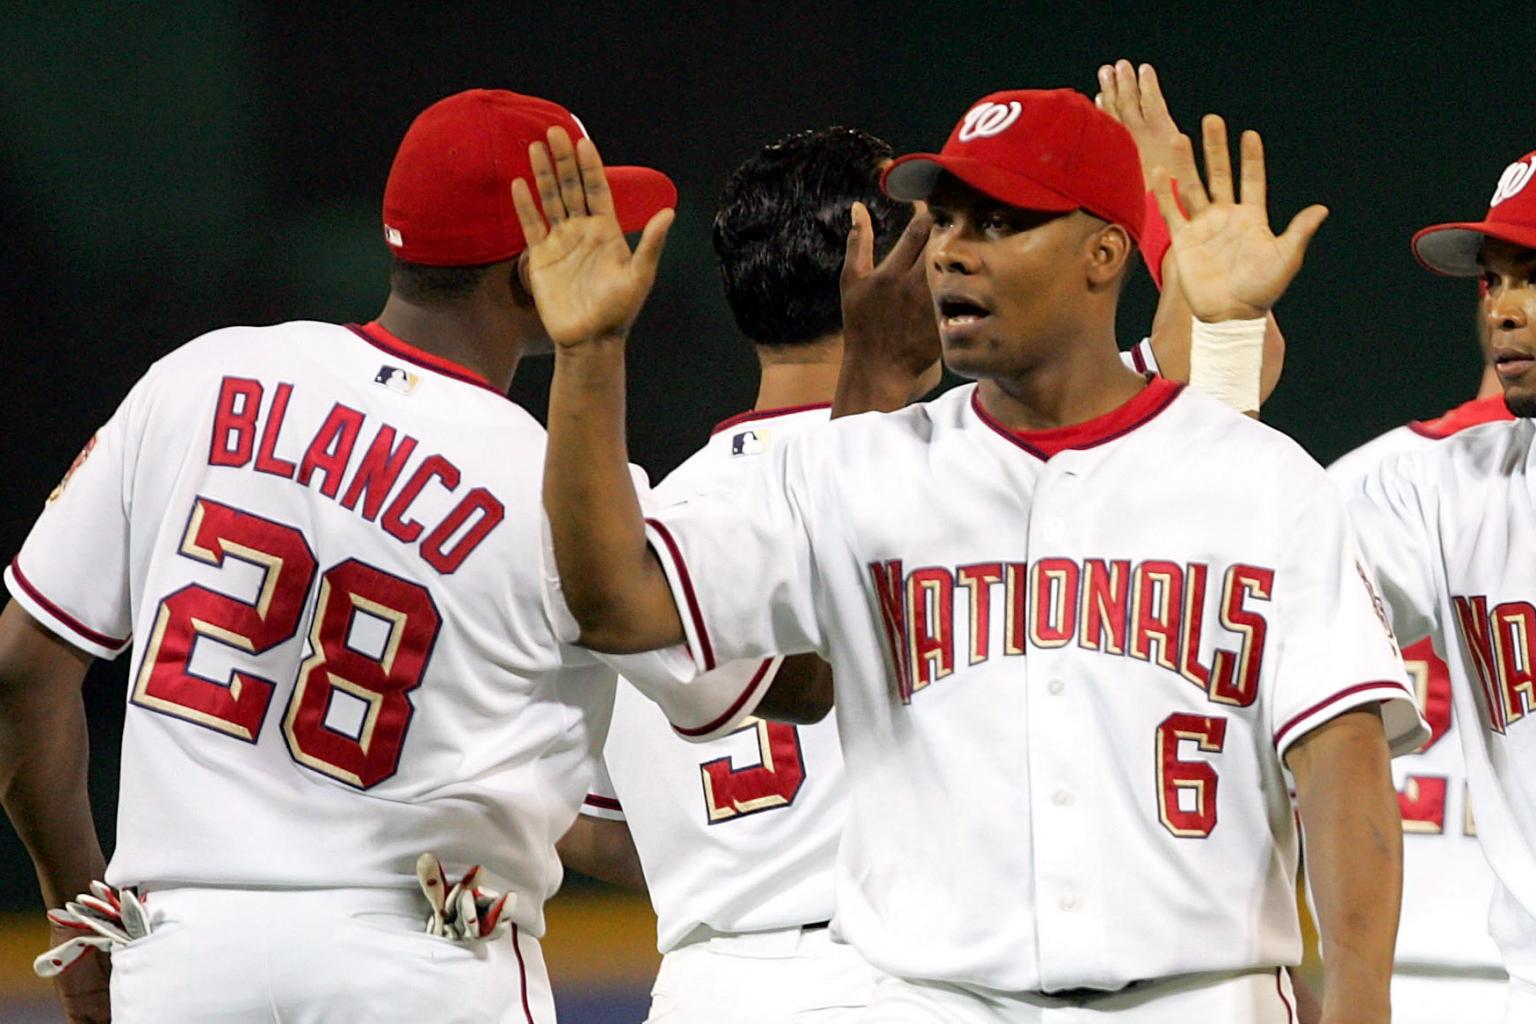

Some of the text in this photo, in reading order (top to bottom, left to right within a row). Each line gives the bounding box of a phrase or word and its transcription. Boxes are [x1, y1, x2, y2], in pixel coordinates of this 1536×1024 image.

[208, 375, 506, 575] BLANCO
[129, 494, 443, 791] 28
[868, 556, 1276, 708] NATIONALS
[1155, 712, 1228, 839] 6
